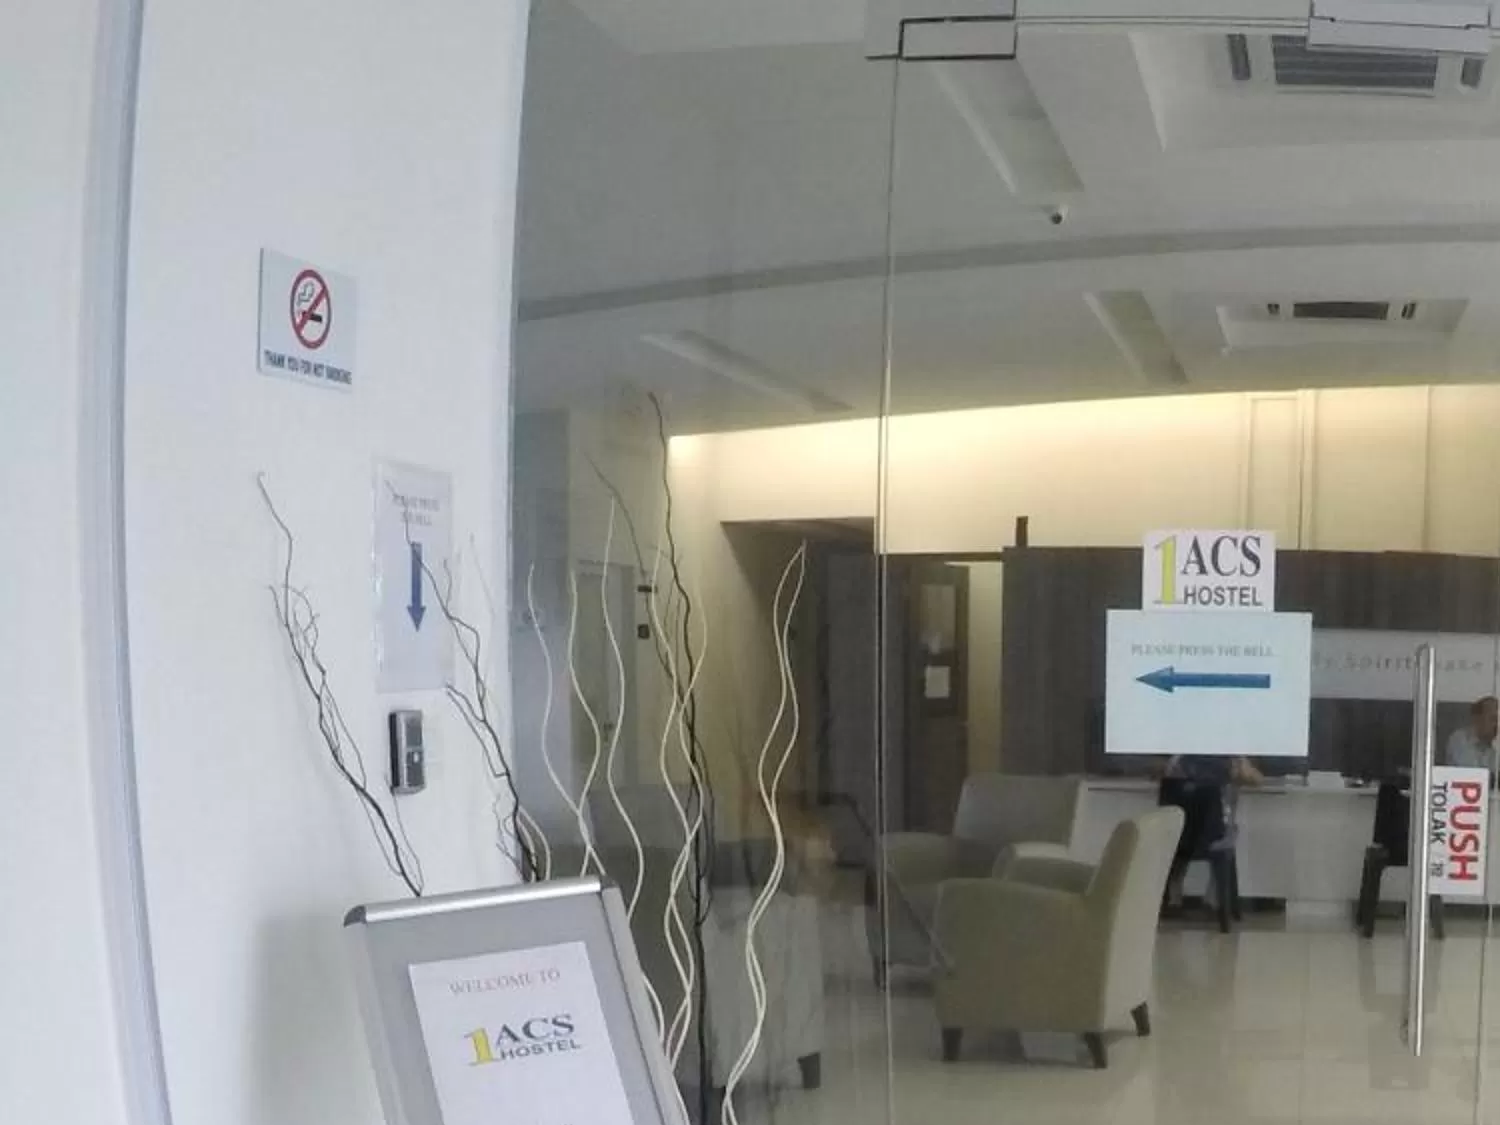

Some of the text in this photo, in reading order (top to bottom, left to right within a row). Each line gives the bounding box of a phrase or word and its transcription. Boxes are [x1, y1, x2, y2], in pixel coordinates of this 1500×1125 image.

[1183, 584, 1264, 607] HOSTEL
[1431, 782, 1448, 844] TOLAK
[1448, 781, 1482, 881] PUSH
[448, 967, 561, 994] WELCOME TO
[500, 1038, 582, 1061] HOSTEL
